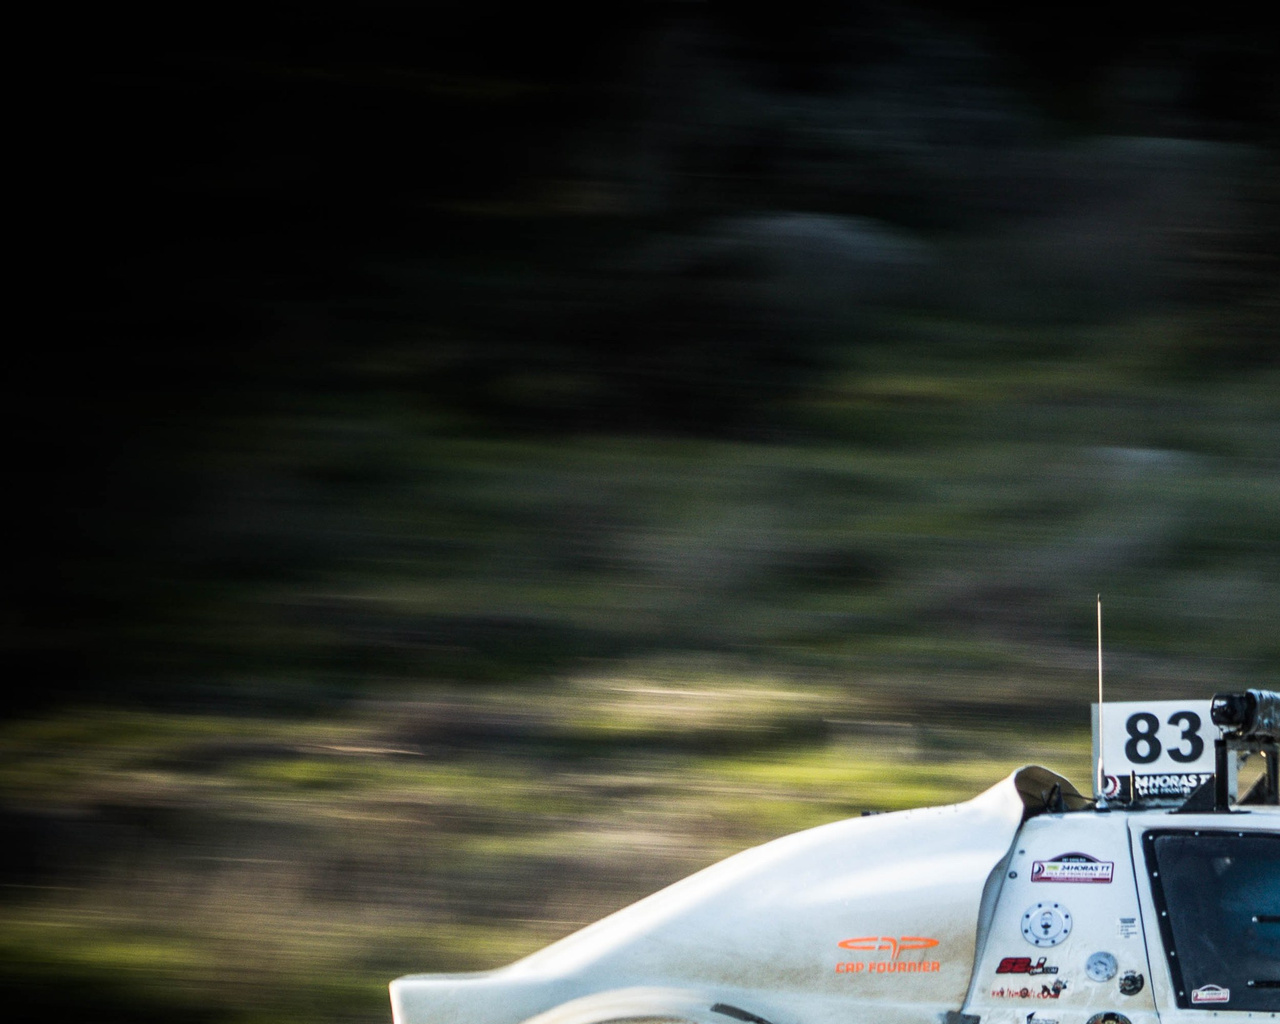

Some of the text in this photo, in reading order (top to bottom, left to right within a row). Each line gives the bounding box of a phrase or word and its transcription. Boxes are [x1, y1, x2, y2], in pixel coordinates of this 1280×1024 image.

[1124, 711, 1204, 764] 83
[835, 961, 940, 973] CAP FOURNIER
